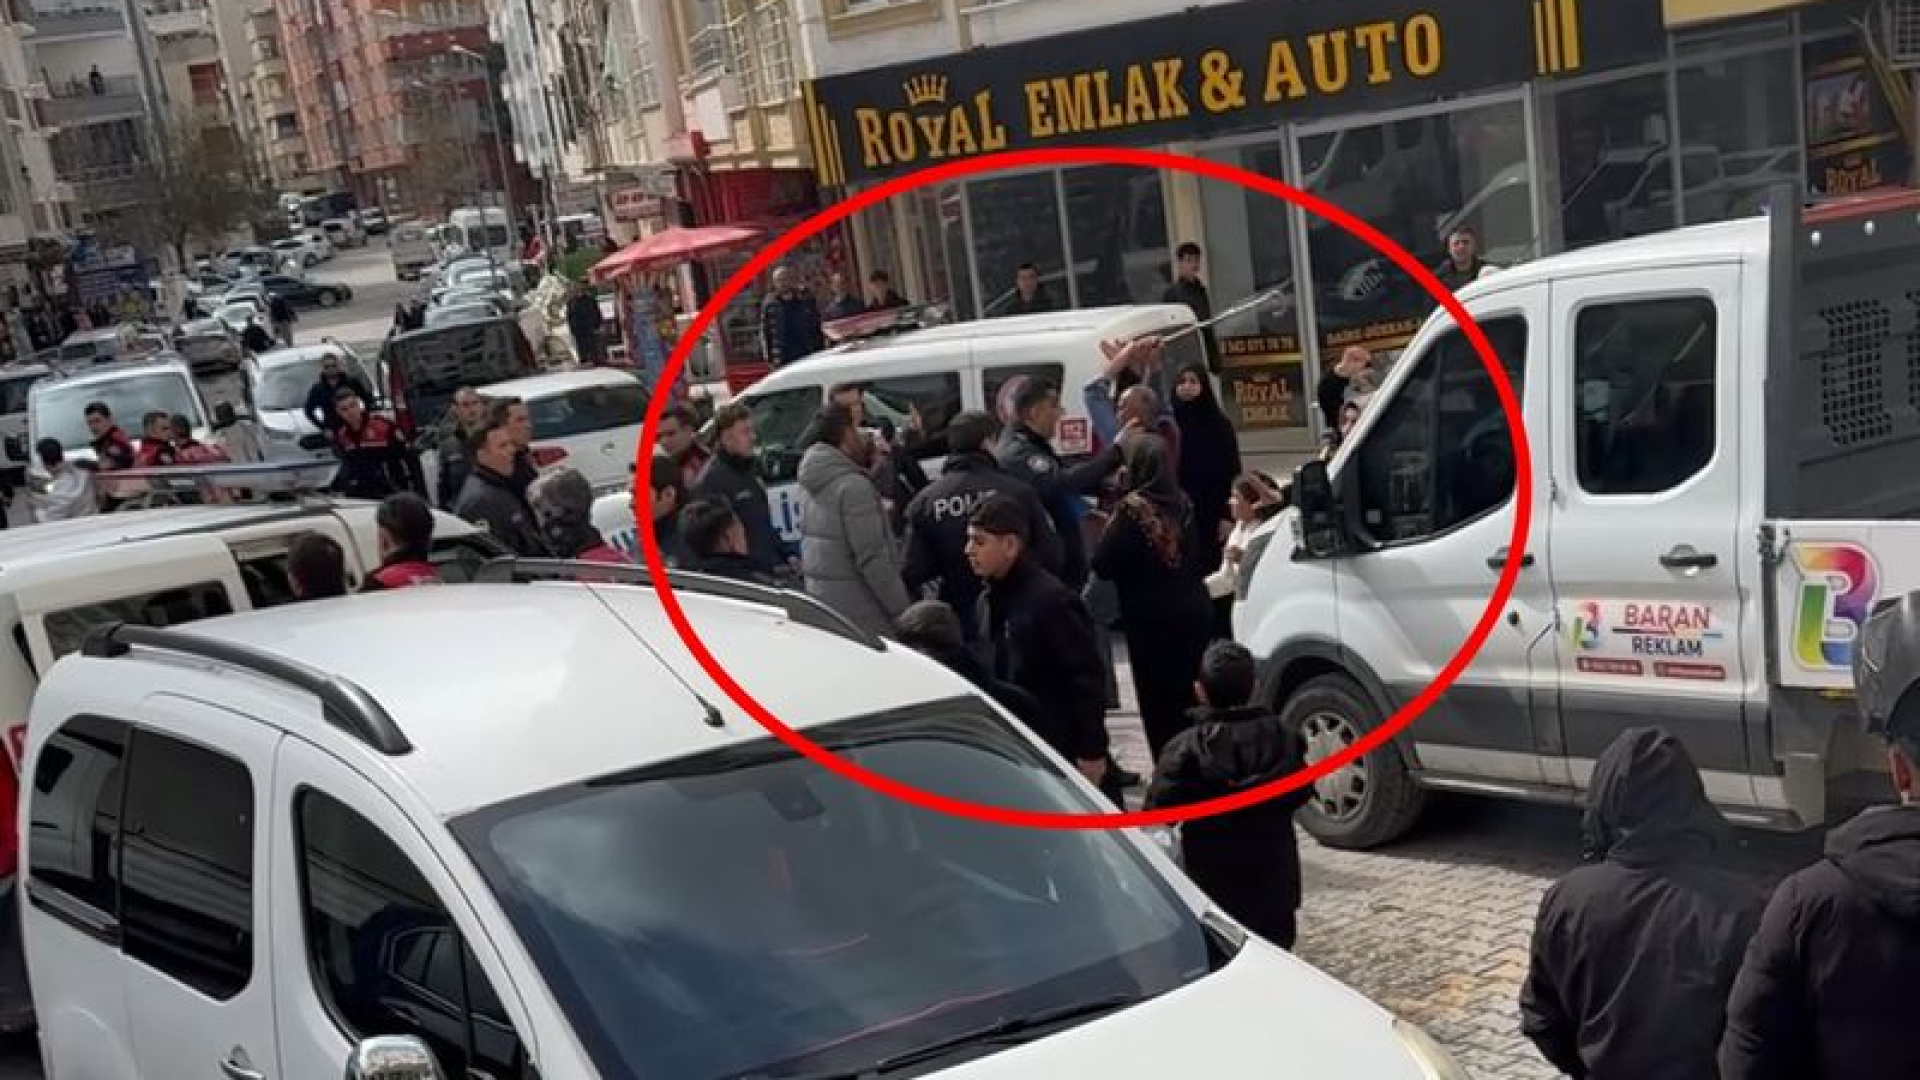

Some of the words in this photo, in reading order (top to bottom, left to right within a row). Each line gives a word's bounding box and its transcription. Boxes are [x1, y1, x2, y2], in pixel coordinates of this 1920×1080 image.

[855, 89, 1007, 168] ROYAL
[1024, 56, 1190, 139] EMLAK
[1199, 48, 1246, 113] &
[1264, 13, 1442, 103] AUTO
[1624, 604, 1711, 637] BARAN
[1631, 635, 1704, 659] REKLAM
